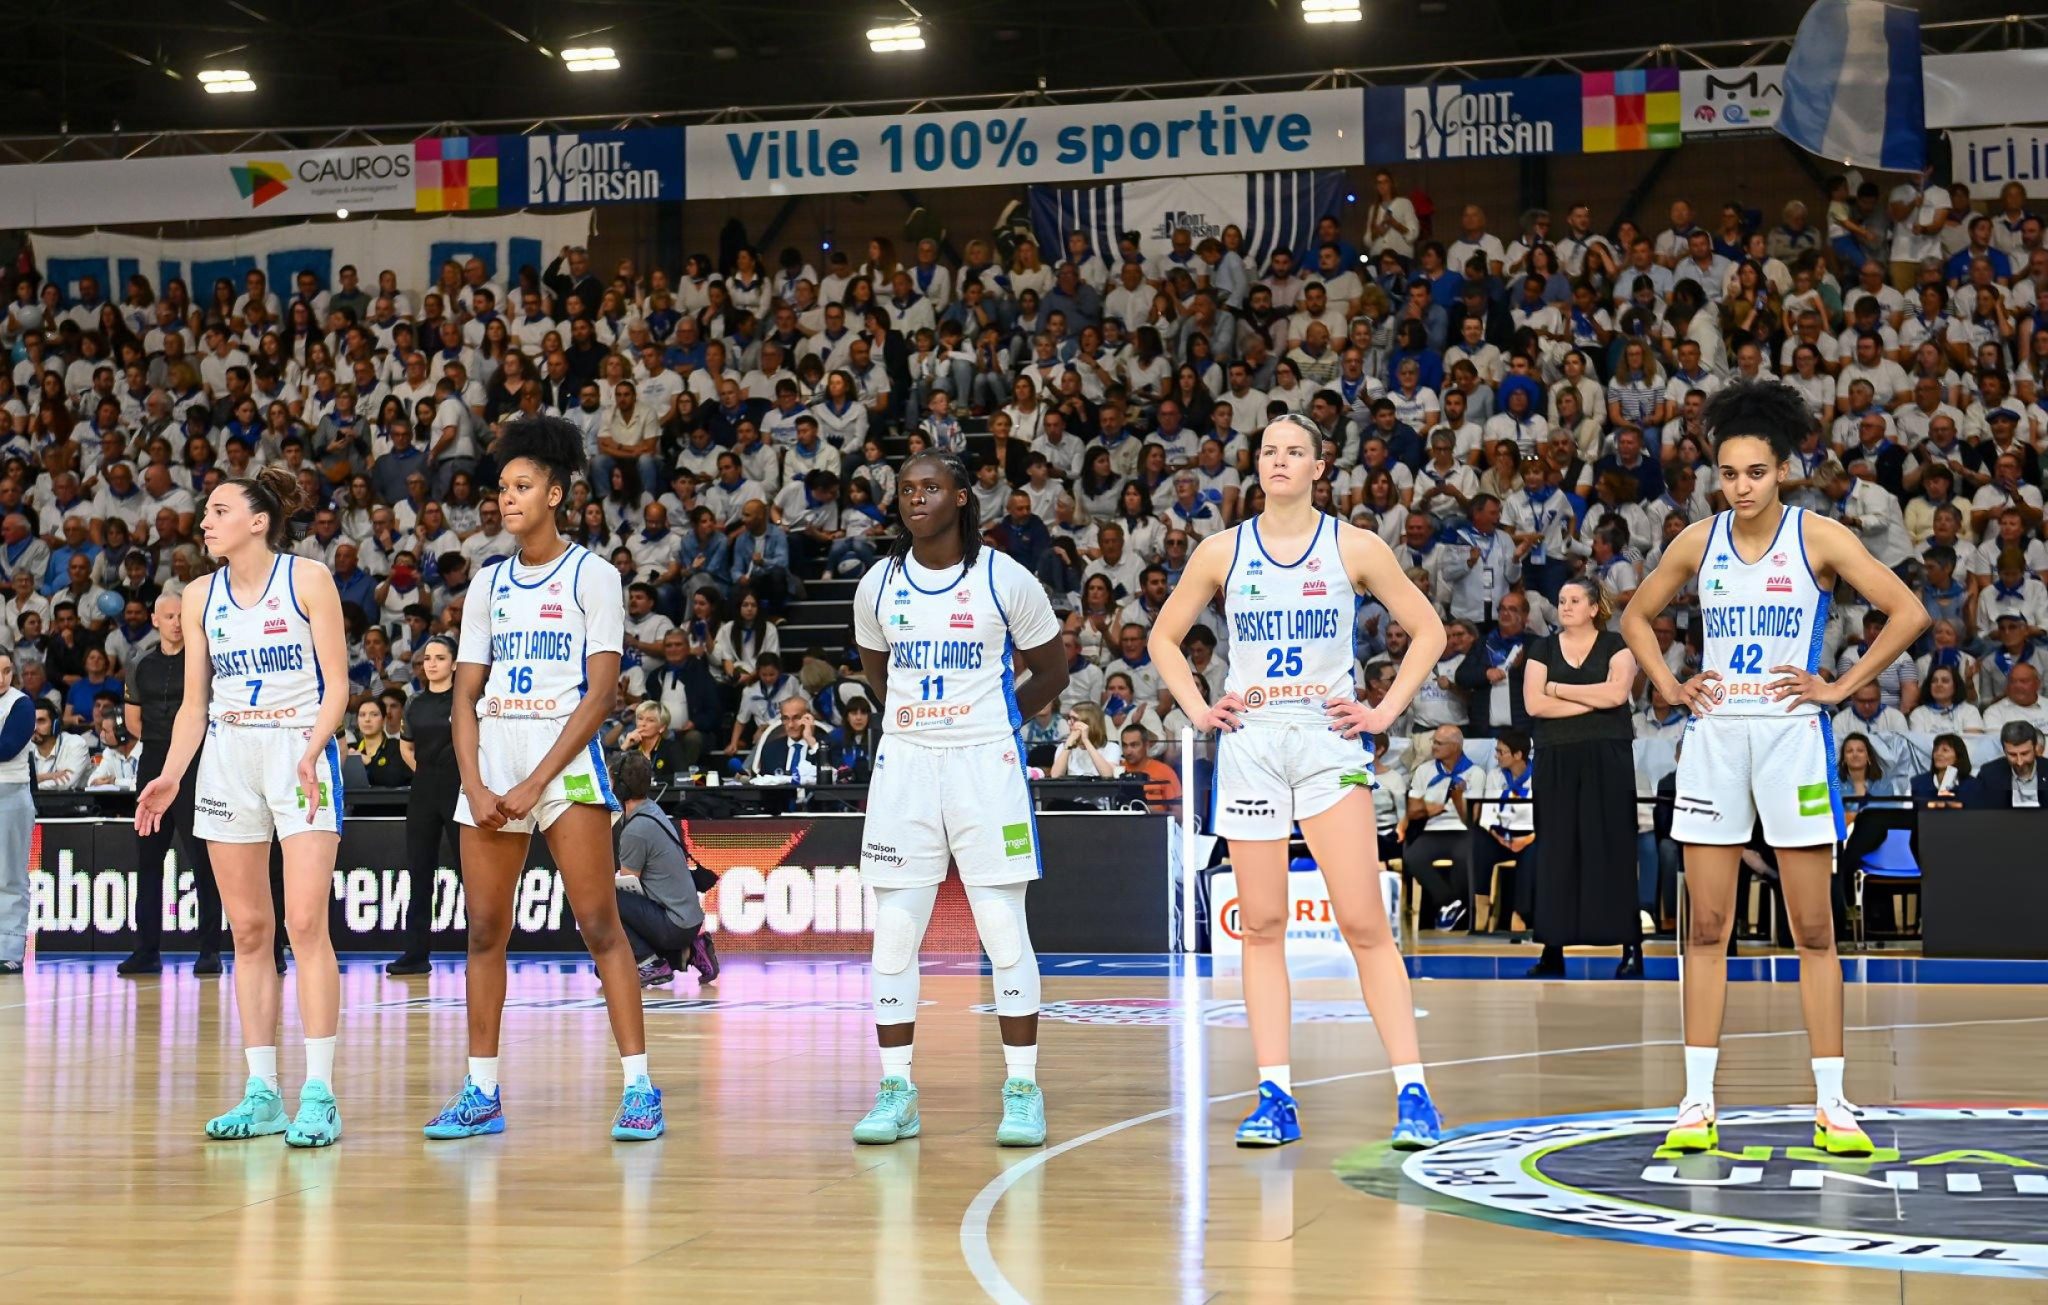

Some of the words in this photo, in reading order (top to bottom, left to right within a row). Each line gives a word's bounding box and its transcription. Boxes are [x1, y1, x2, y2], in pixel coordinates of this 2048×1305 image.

[726, 131, 860, 181] Ville
[880, 117, 1039, 174] 100%
[1056, 105, 1312, 174] sportive
[298, 154, 411, 183] CAUROS
[1234, 610, 1283, 642] BASKET
[1287, 608, 1339, 640] LANDES
[1749, 605, 1803, 638] LANDES
[251, 643, 303, 675] LANDES
[525, 630, 572, 662] LANDES
[934, 640, 984, 670] LANDES
[1729, 643, 1763, 674] 42
[1266, 646, 1303, 678] 25
[245, 680, 263, 706] 7
[507, 666, 533, 694] 16
[919, 675, 944, 700] 11
[1269, 684, 1328, 698] BRICO
[242, 707, 298, 721] BRICO
[503, 698, 557, 711] BRICO
[916, 704, 972, 718] BRICO
[200, 796, 227, 808] maison
[867, 842, 896, 853] maison
